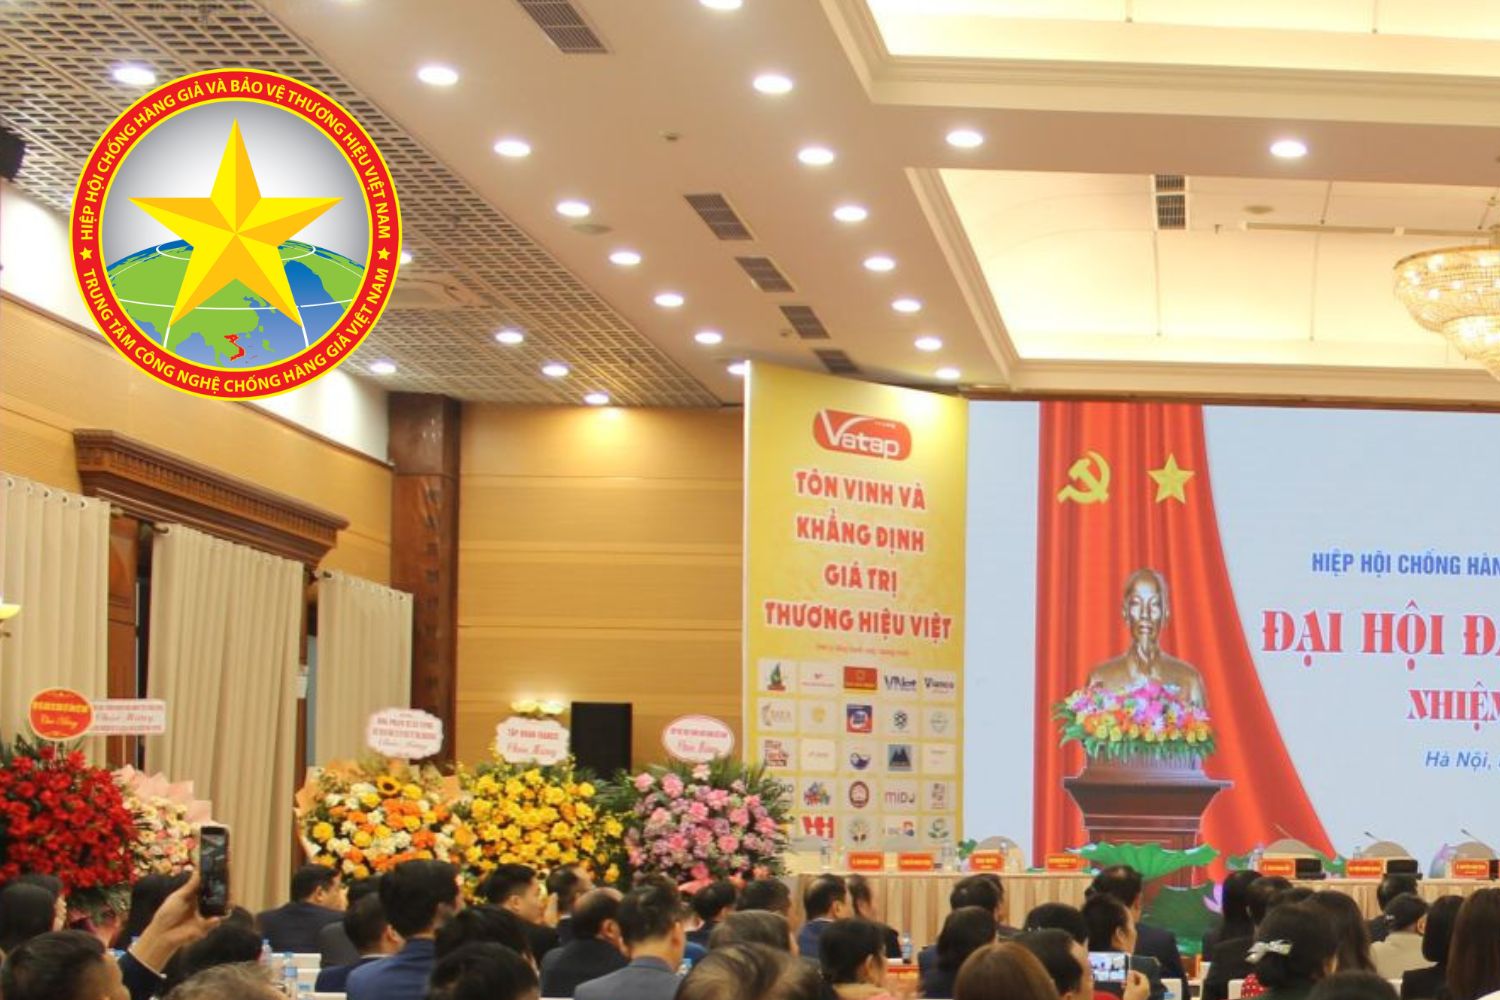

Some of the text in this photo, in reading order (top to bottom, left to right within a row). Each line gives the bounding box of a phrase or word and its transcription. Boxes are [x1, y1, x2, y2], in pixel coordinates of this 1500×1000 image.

[821, 410, 900, 458] Vatap
[796, 468, 926, 510] TÔN VINH VÀ
[876, 526, 924, 554] ĐỊNH
[824, 560, 897, 598] GIÁ TRỊ
[1311, 548, 1354, 577] HIỆP
[1360, 550, 1391, 578] HỘI
[1398, 548, 1461, 576] CHỐNG
[766, 601, 952, 643] THƯƠNG HIỆU VIỆT
[1262, 609, 1343, 668] ĐẠI
[1361, 599, 1445, 672] HỘI
[1425, 751, 1450, 768] Hà
[1456, 751, 1493, 772] Nội,
